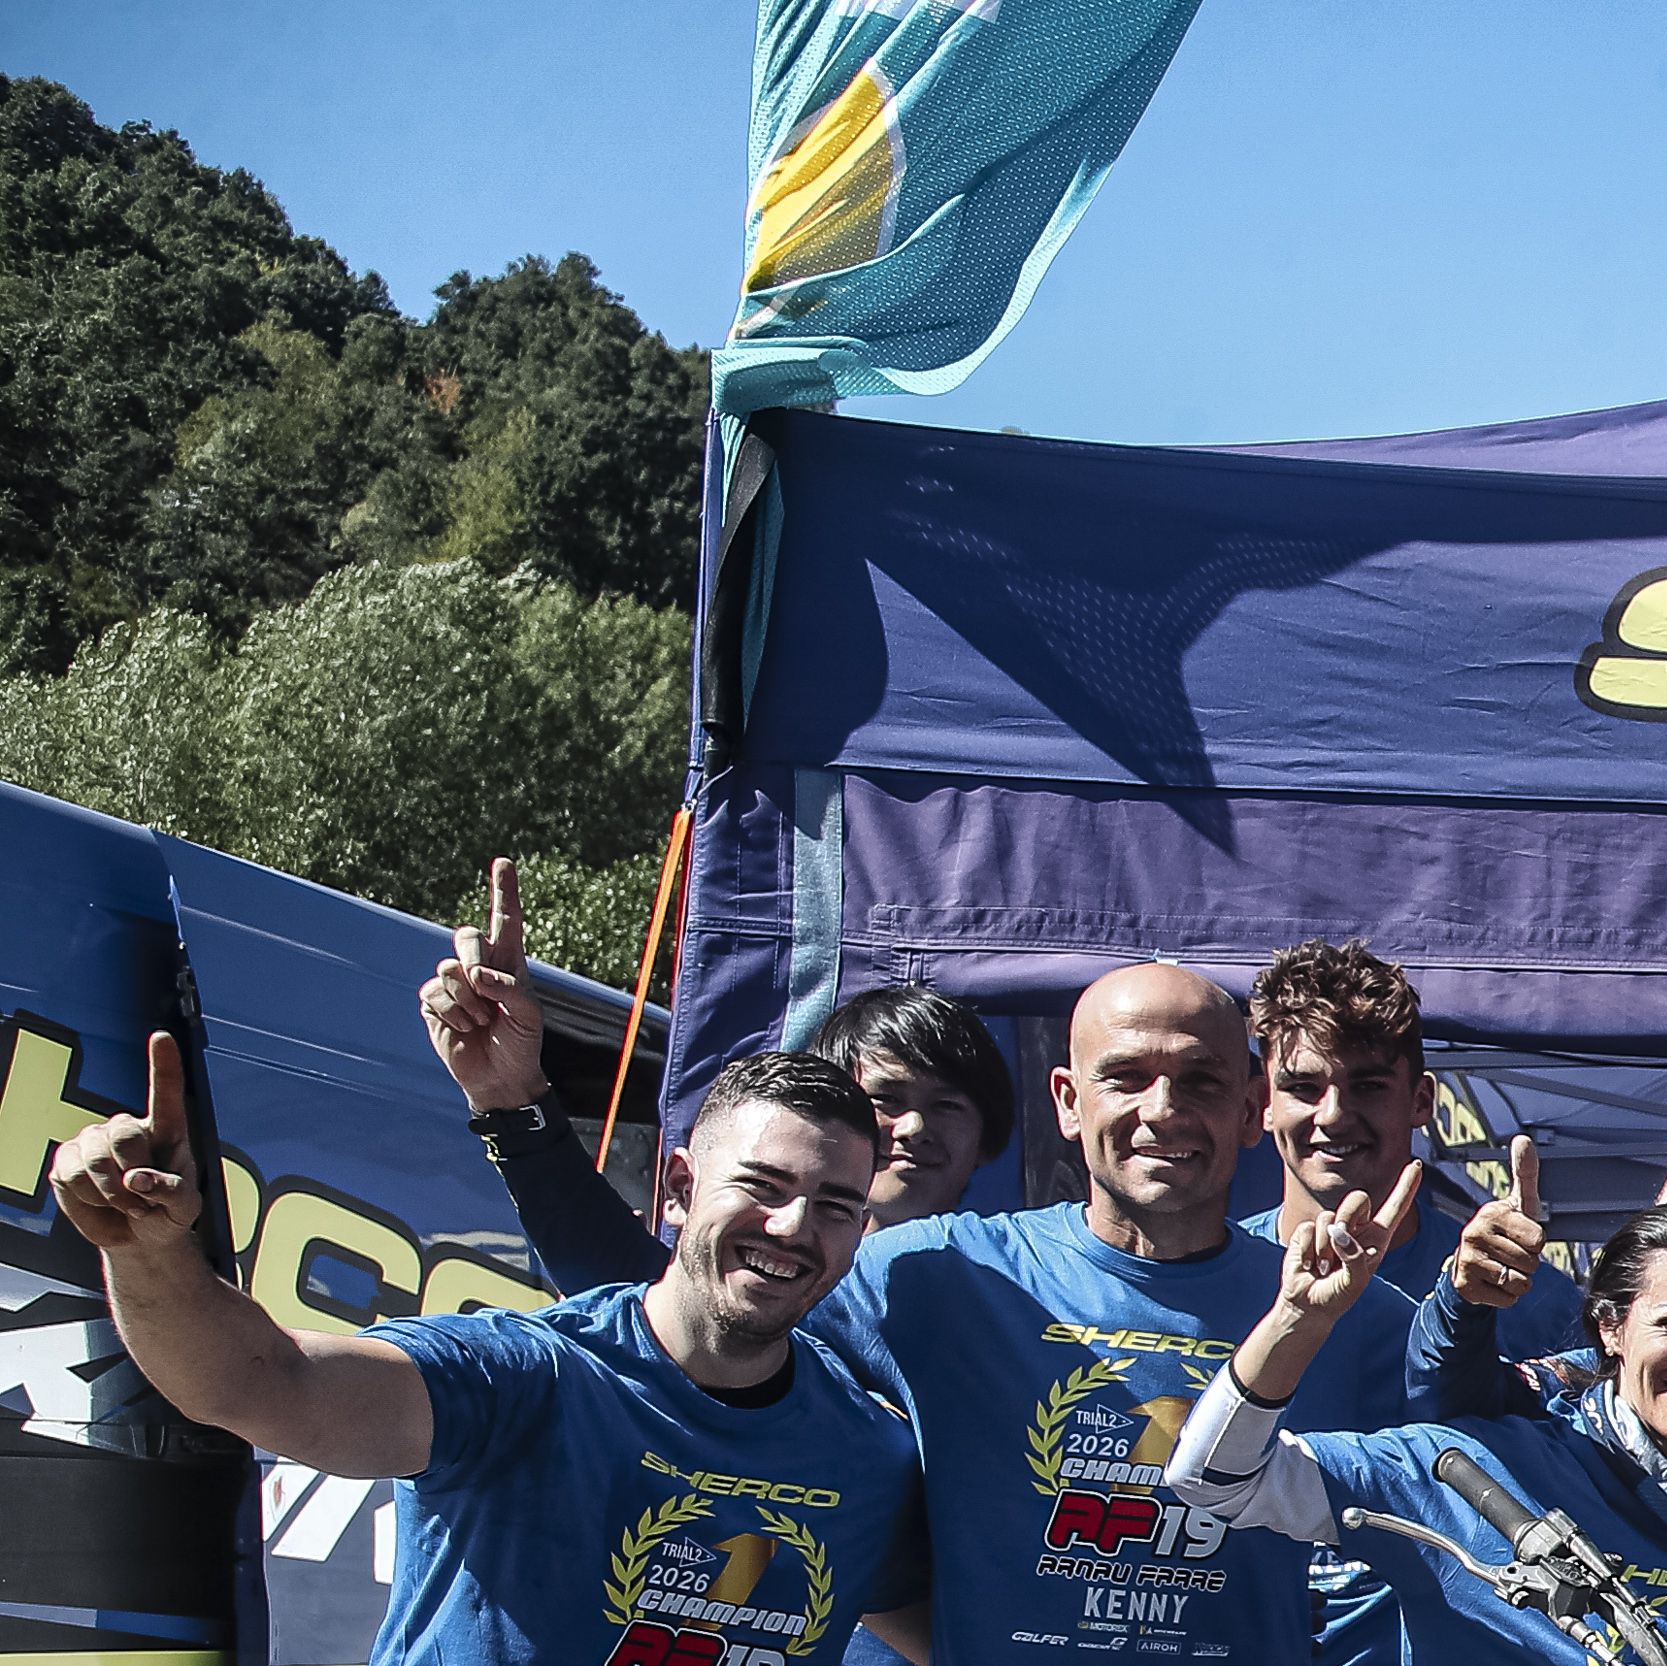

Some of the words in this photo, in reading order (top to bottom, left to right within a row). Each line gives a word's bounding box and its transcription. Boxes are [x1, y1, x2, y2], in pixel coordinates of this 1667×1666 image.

[1040, 1323, 1238, 1361] SHERC
[1067, 1433, 1129, 1458] 2026
[641, 1451, 841, 1508] SHERCO
[1061, 1457, 1168, 1488] CHAM
[648, 1564, 711, 1592] 2026
[637, 1588, 808, 1637] CHAMPION
[1083, 1586, 1189, 1624] KENNY
